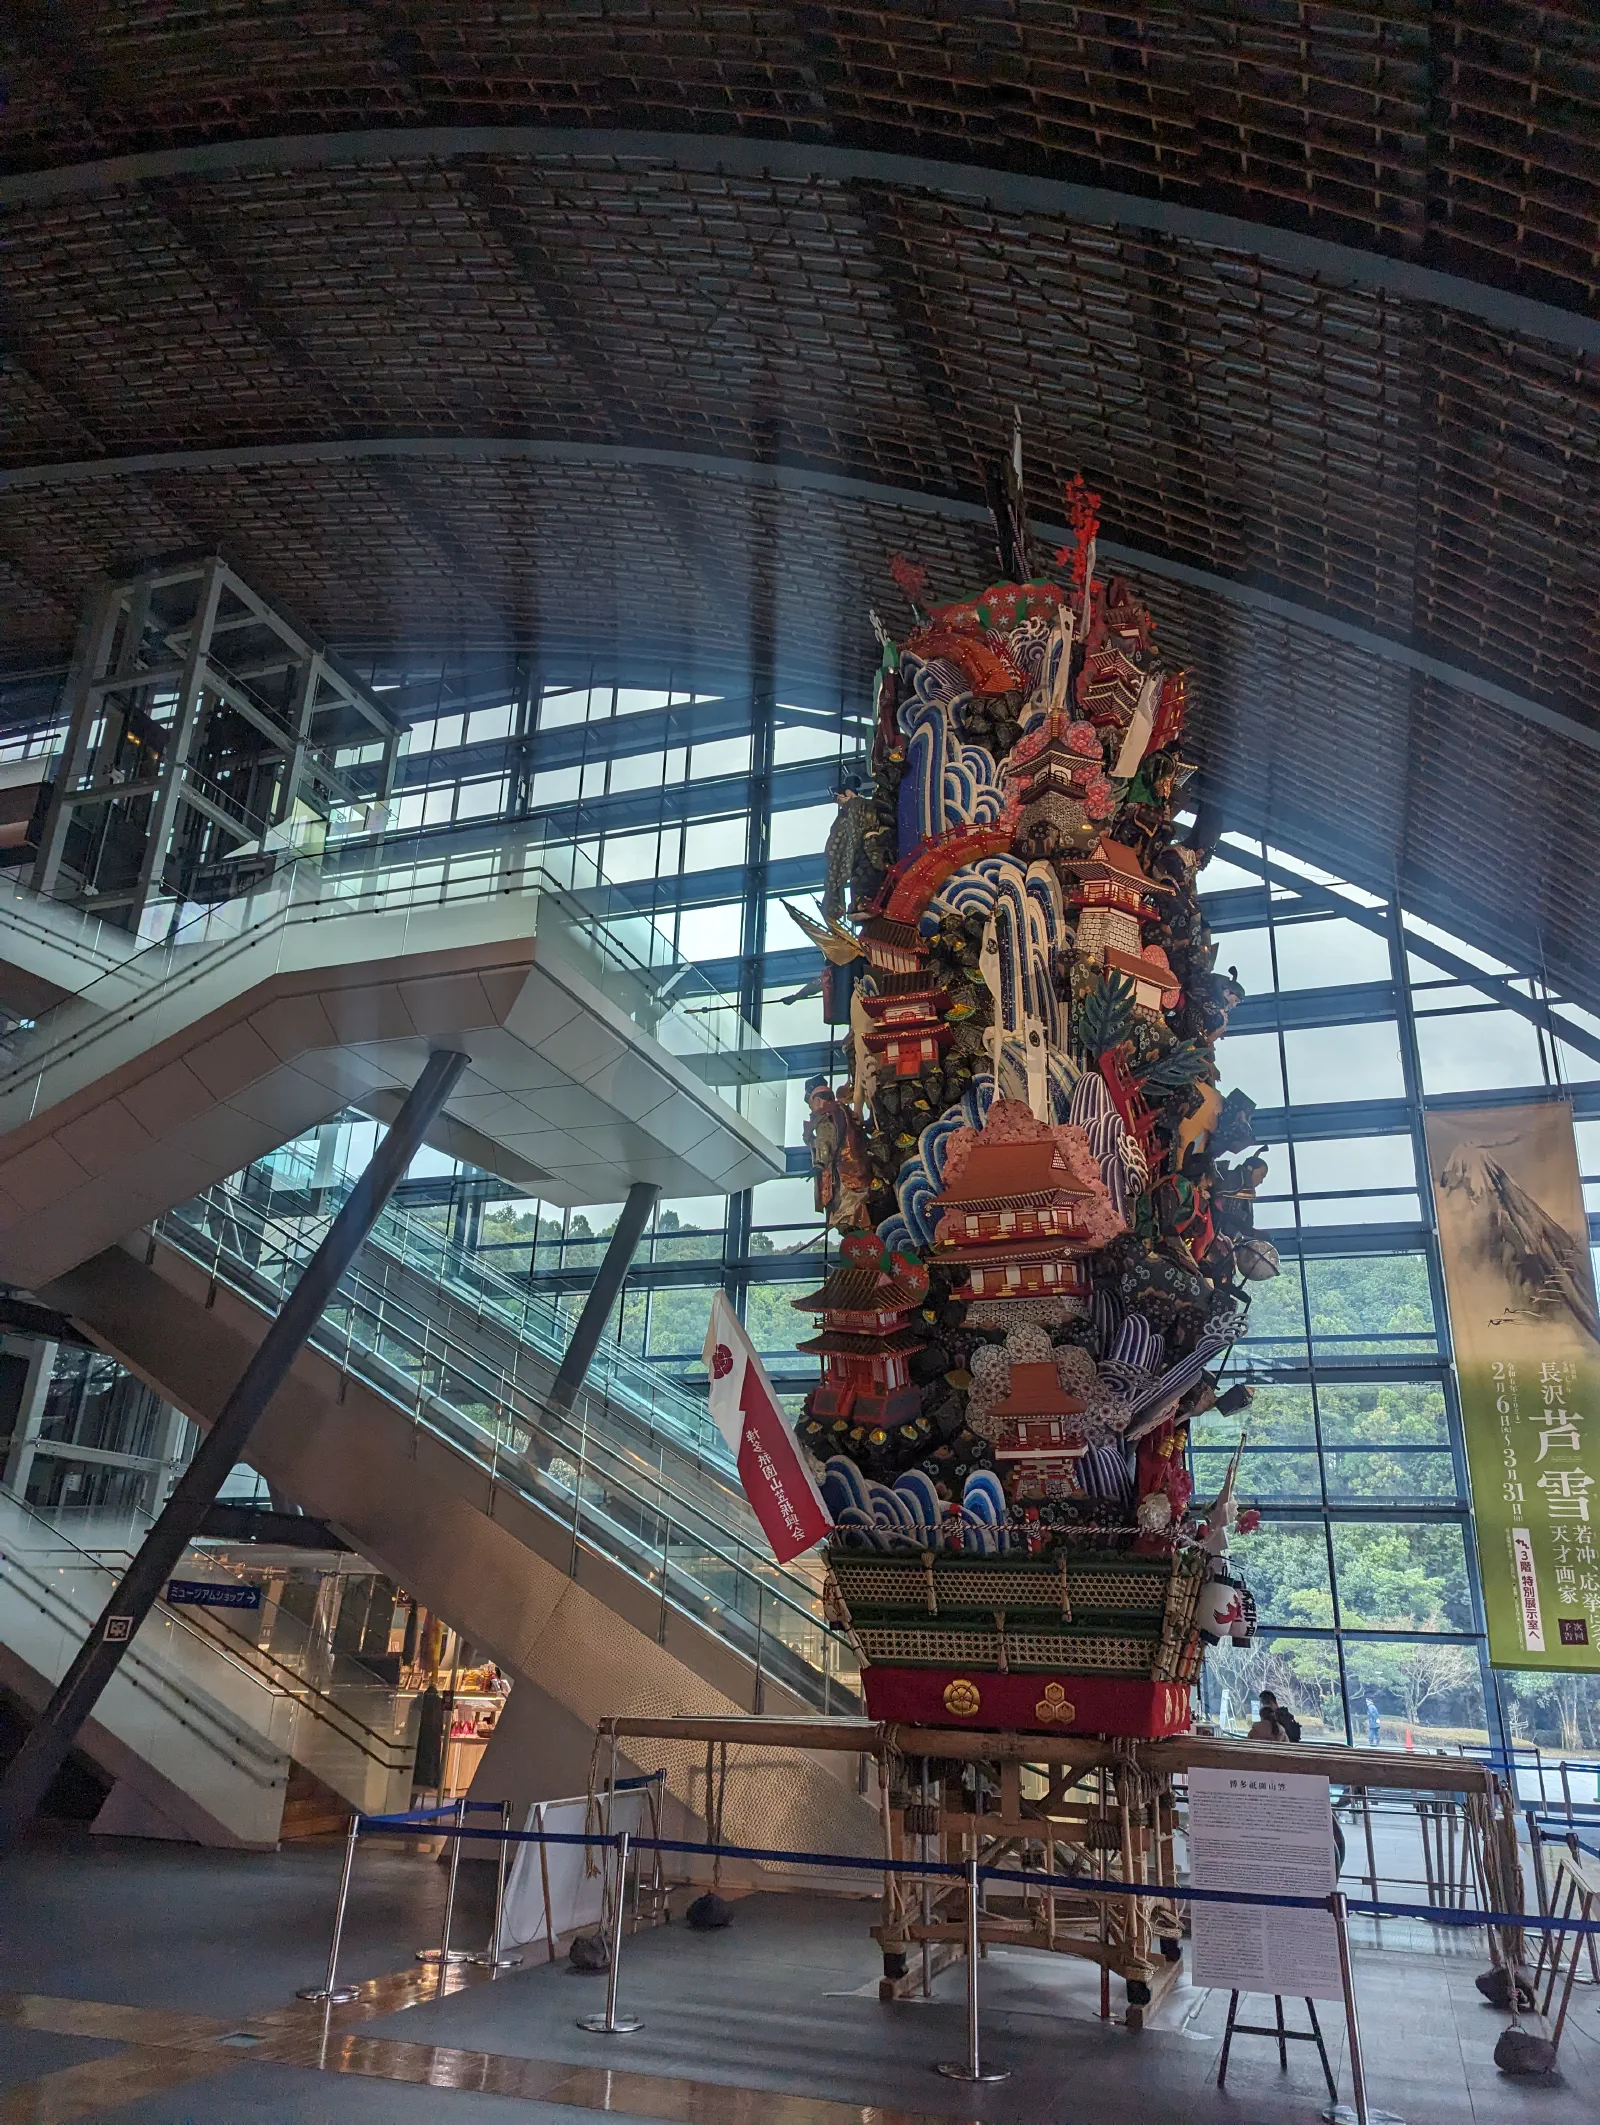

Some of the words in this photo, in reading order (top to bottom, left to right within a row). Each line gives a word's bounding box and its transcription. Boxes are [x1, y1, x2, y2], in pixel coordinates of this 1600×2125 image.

[1528, 1361, 1595, 1522] 長沢芦雪
[1520, 1551, 1532, 1573] 3階
[1549, 1525, 1579, 1604] 天才画家
[170, 1586, 245, 1602] ミュージアムショップ
[1240, 1589, 1257, 1637] 天神一丁目
[1521, 1576, 1540, 1640] 特別展示室へ
